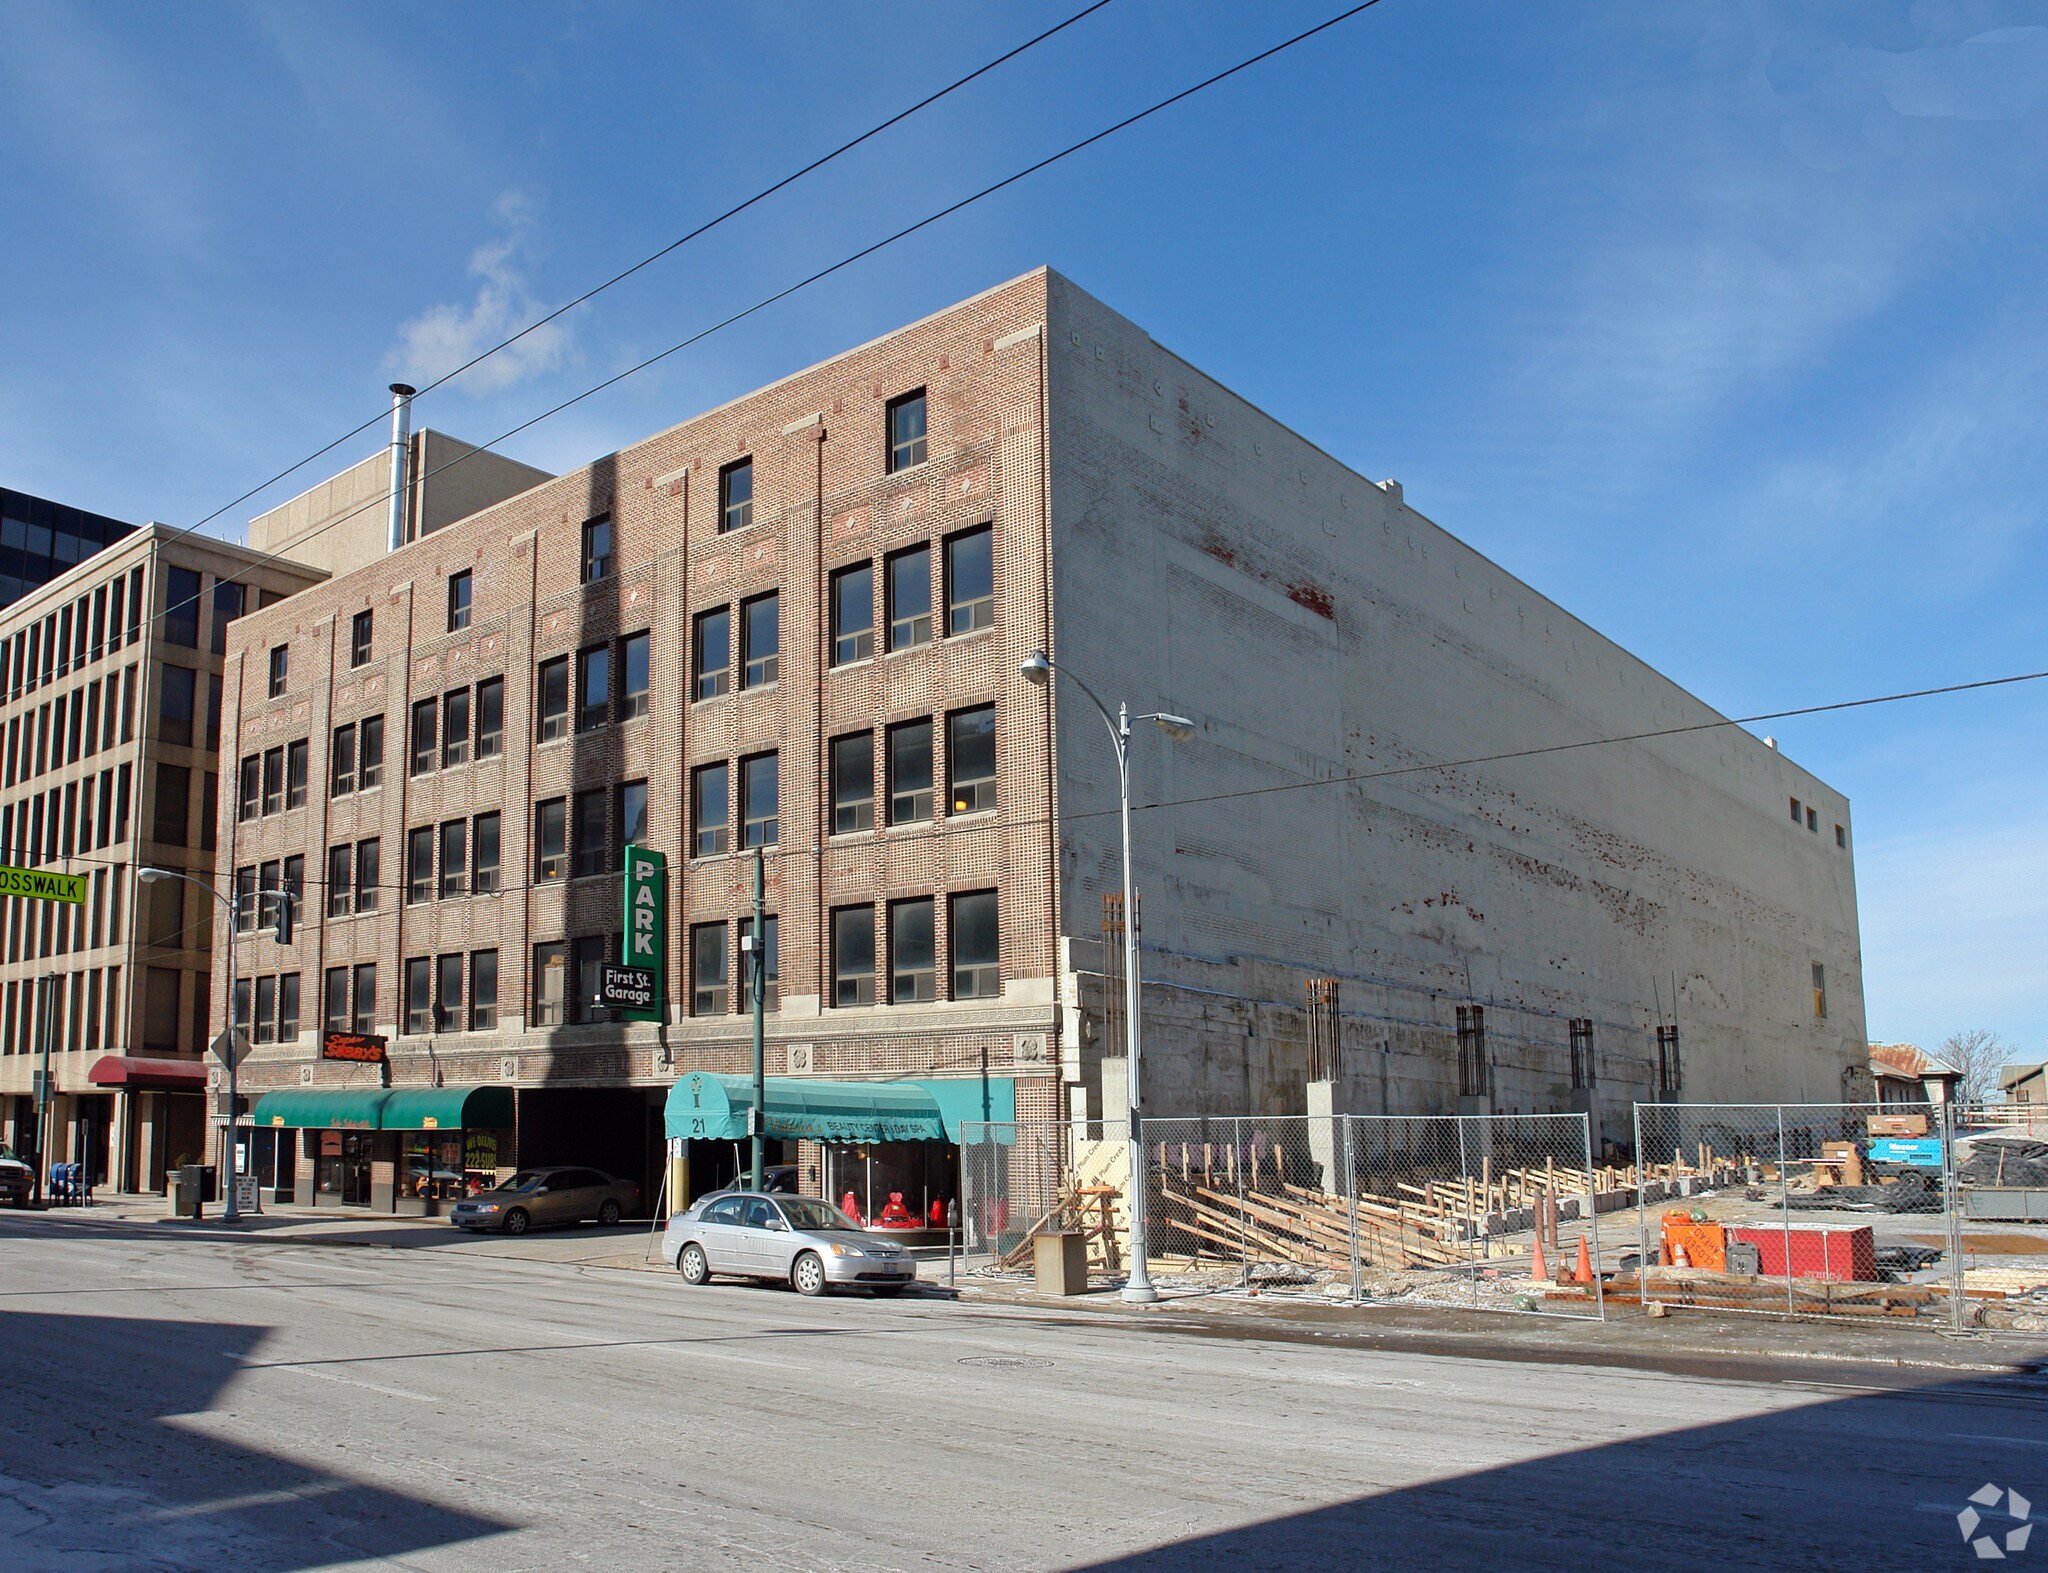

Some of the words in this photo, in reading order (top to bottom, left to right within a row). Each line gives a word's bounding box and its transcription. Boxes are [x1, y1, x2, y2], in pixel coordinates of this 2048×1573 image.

[0, 871, 77, 898] OSSWALK
[635, 859, 656, 956] PARK
[606, 969, 634, 985] First
[635, 972, 651, 989] St.
[605, 984, 650, 1005] Garage
[692, 1118, 706, 1134] 21
[827, 1121, 859, 1132] BEAUTY
[861, 1123, 889, 1134] CENTER
[895, 1124, 909, 1134] DAY
[910, 1124, 927, 1134] SPA
[1099, 1162, 1112, 1178] Plum
[1110, 1146, 1125, 1163] Creek
[1685, 1236, 1714, 1266] CLOSED
